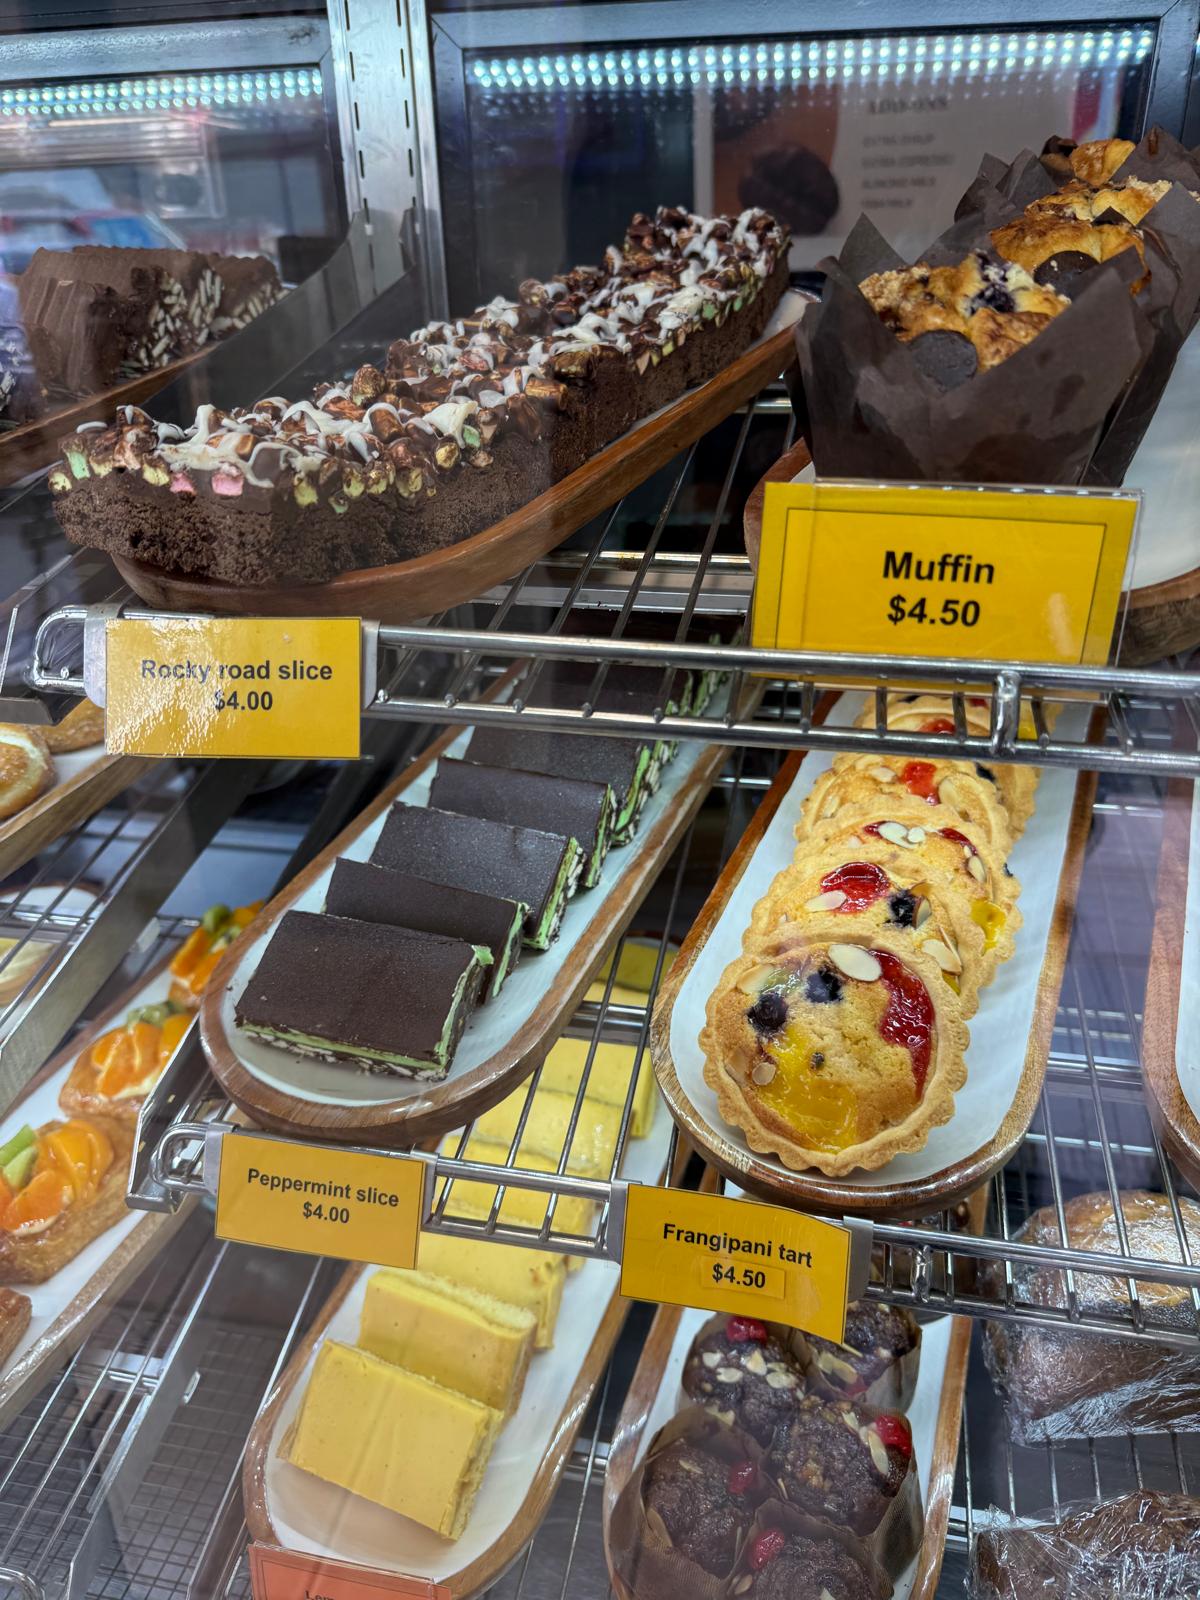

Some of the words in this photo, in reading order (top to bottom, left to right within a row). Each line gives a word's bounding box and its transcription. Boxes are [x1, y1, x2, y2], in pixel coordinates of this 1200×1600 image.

[883, 550, 995, 584] Muffin
[887, 594, 980, 627] $4.50
[141, 659, 211, 683] Rocky
[219, 659, 270, 680] road
[278, 660, 333, 681] slice
[214, 689, 273, 712] $4.00
[247, 1168, 351, 1199] Peppermint
[356, 1187, 400, 1207] slice
[302, 1201, 350, 1224] $4.00
[663, 1223, 772, 1257] Frangipani
[778, 1244, 813, 1268] tart
[712, 1263, 766, 1289] $4.50
